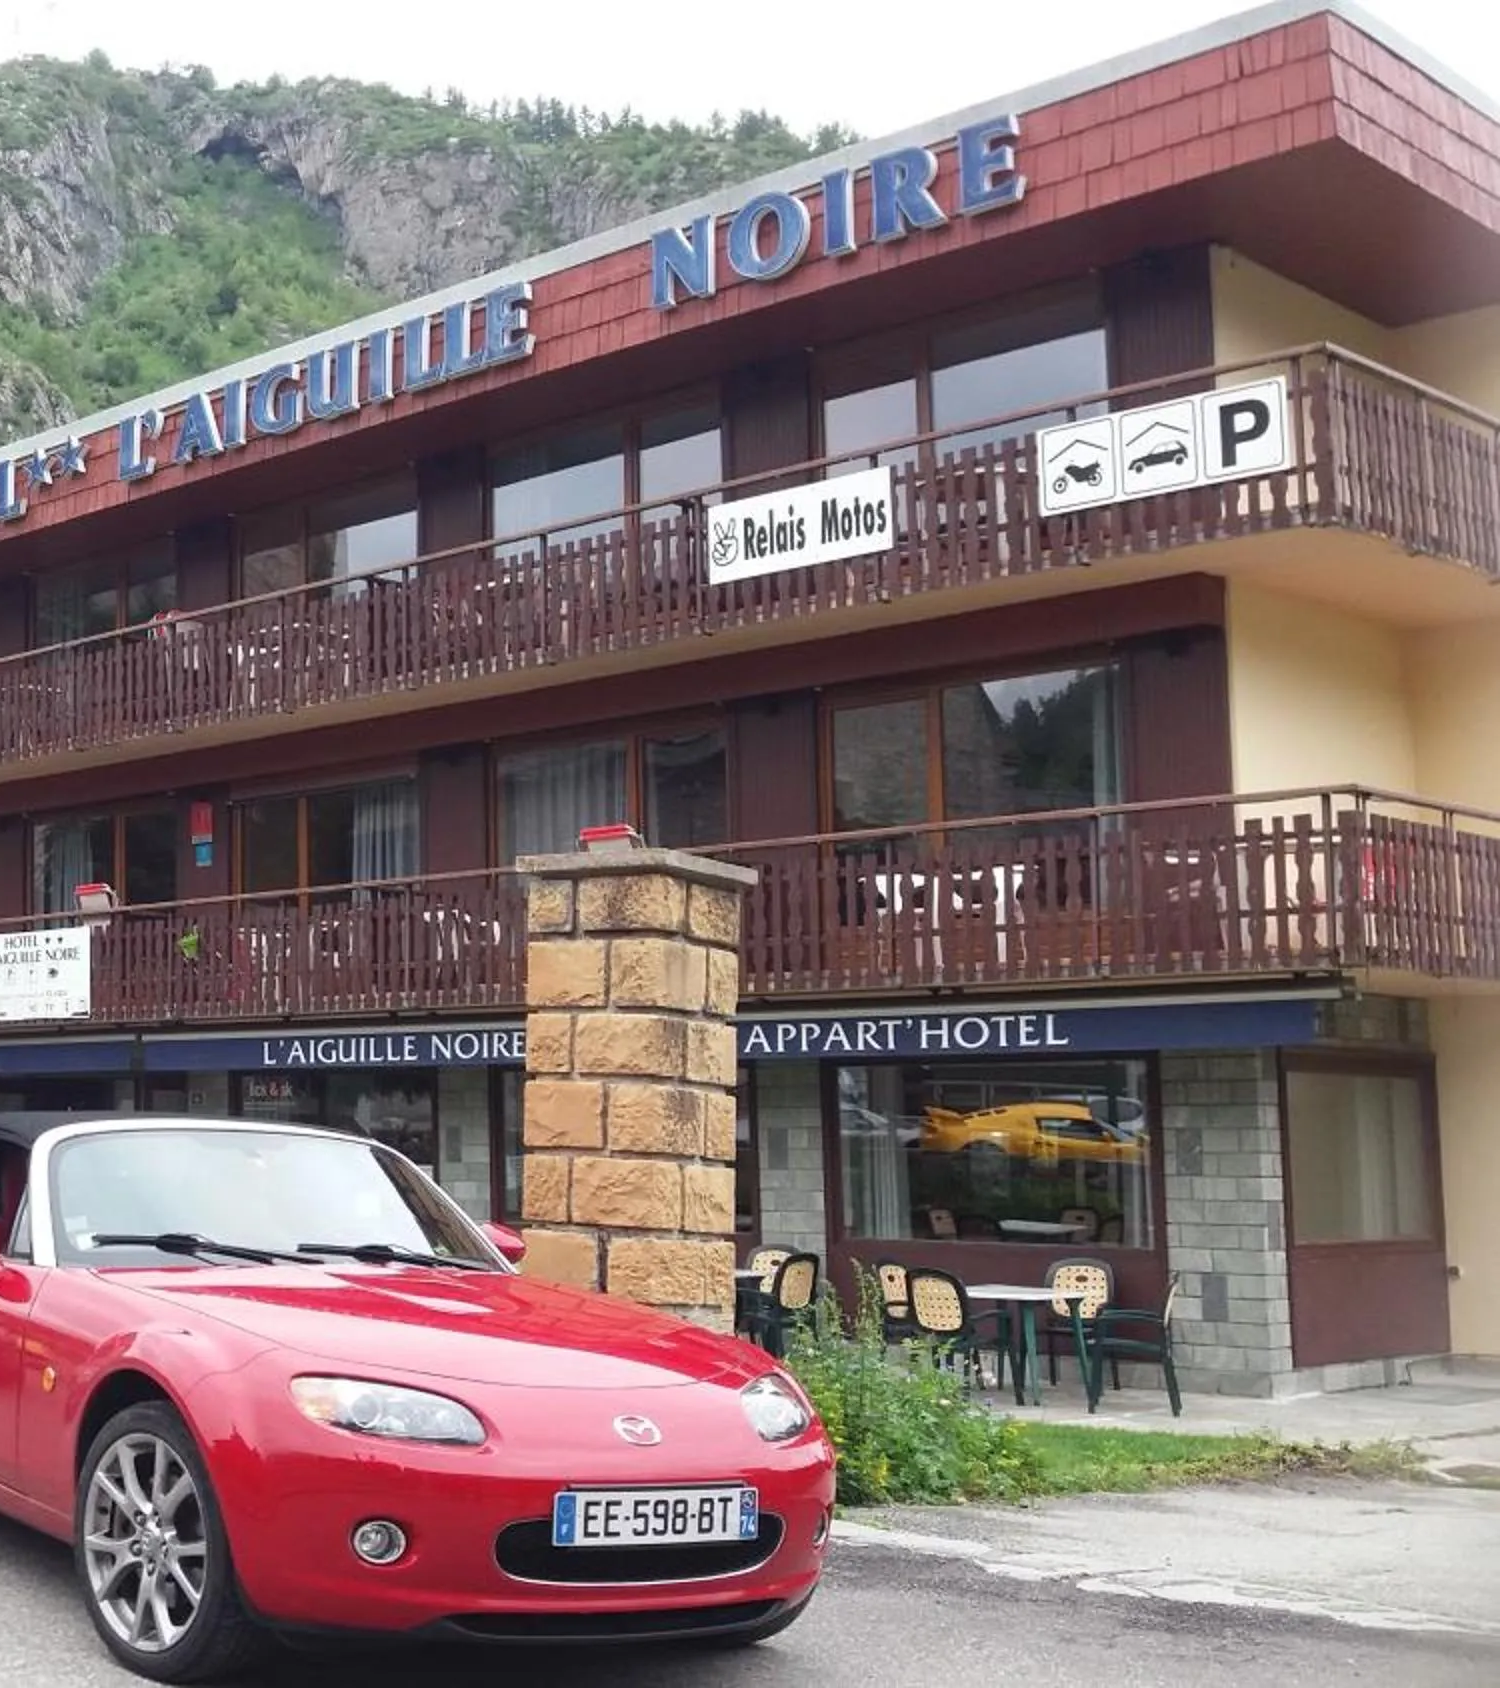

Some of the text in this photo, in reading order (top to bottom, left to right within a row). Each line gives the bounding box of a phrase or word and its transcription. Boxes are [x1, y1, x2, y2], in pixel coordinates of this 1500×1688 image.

[118, 281, 537, 482] L'AIGUILLE
[651, 112, 1029, 311] NOIRE
[1219, 398, 1270, 469] P
[743, 496, 887, 561] Relais Motos
[3, 934, 39, 950] HOTEL
[45, 946, 81, 961] NOIRE
[262, 1031, 526, 1065] L'AIGUILLE NOIRE
[743, 1013, 1069, 1053] APPART'HOTEL
[582, 1496, 734, 1539] EE-598-BT
